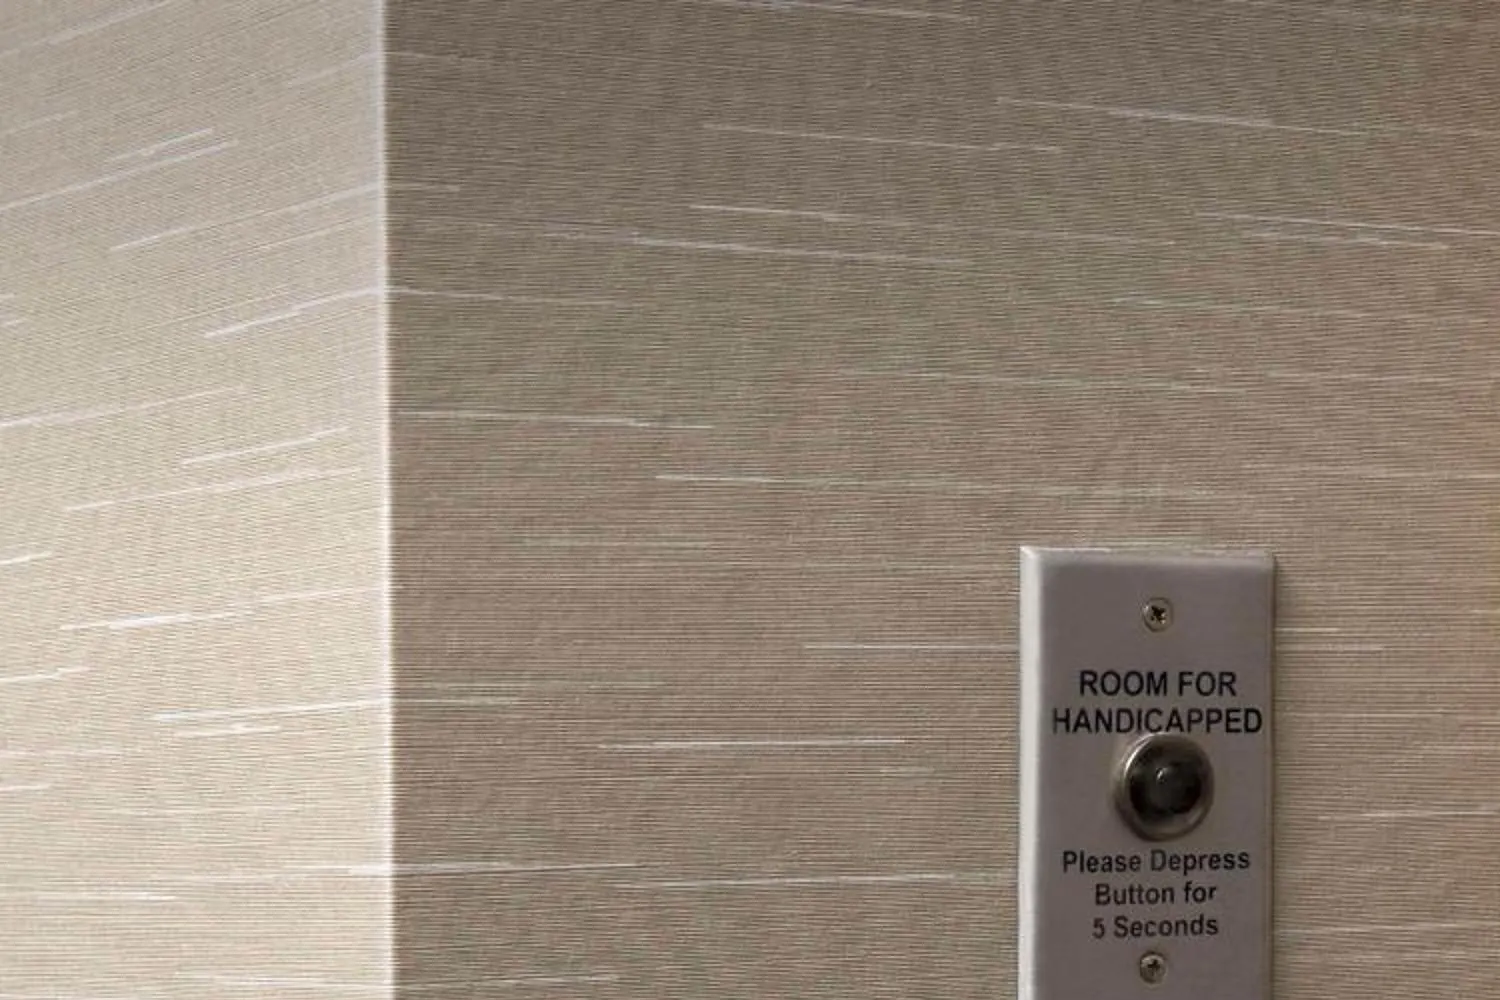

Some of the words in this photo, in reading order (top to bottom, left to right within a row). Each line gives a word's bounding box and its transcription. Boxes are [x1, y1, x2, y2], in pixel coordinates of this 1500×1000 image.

[1079, 670, 1168, 696] ROOM
[1178, 671, 1237, 696] FOR
[1053, 707, 1263, 734] HANDICAPPED
[1062, 850, 1142, 874] Please
[1150, 849, 1251, 876] Depress
[1094, 882, 1175, 906] Button
[1184, 881, 1217, 904] for
[1092, 918, 1105, 939] 5
[1113, 914, 1218, 938] Seconds
